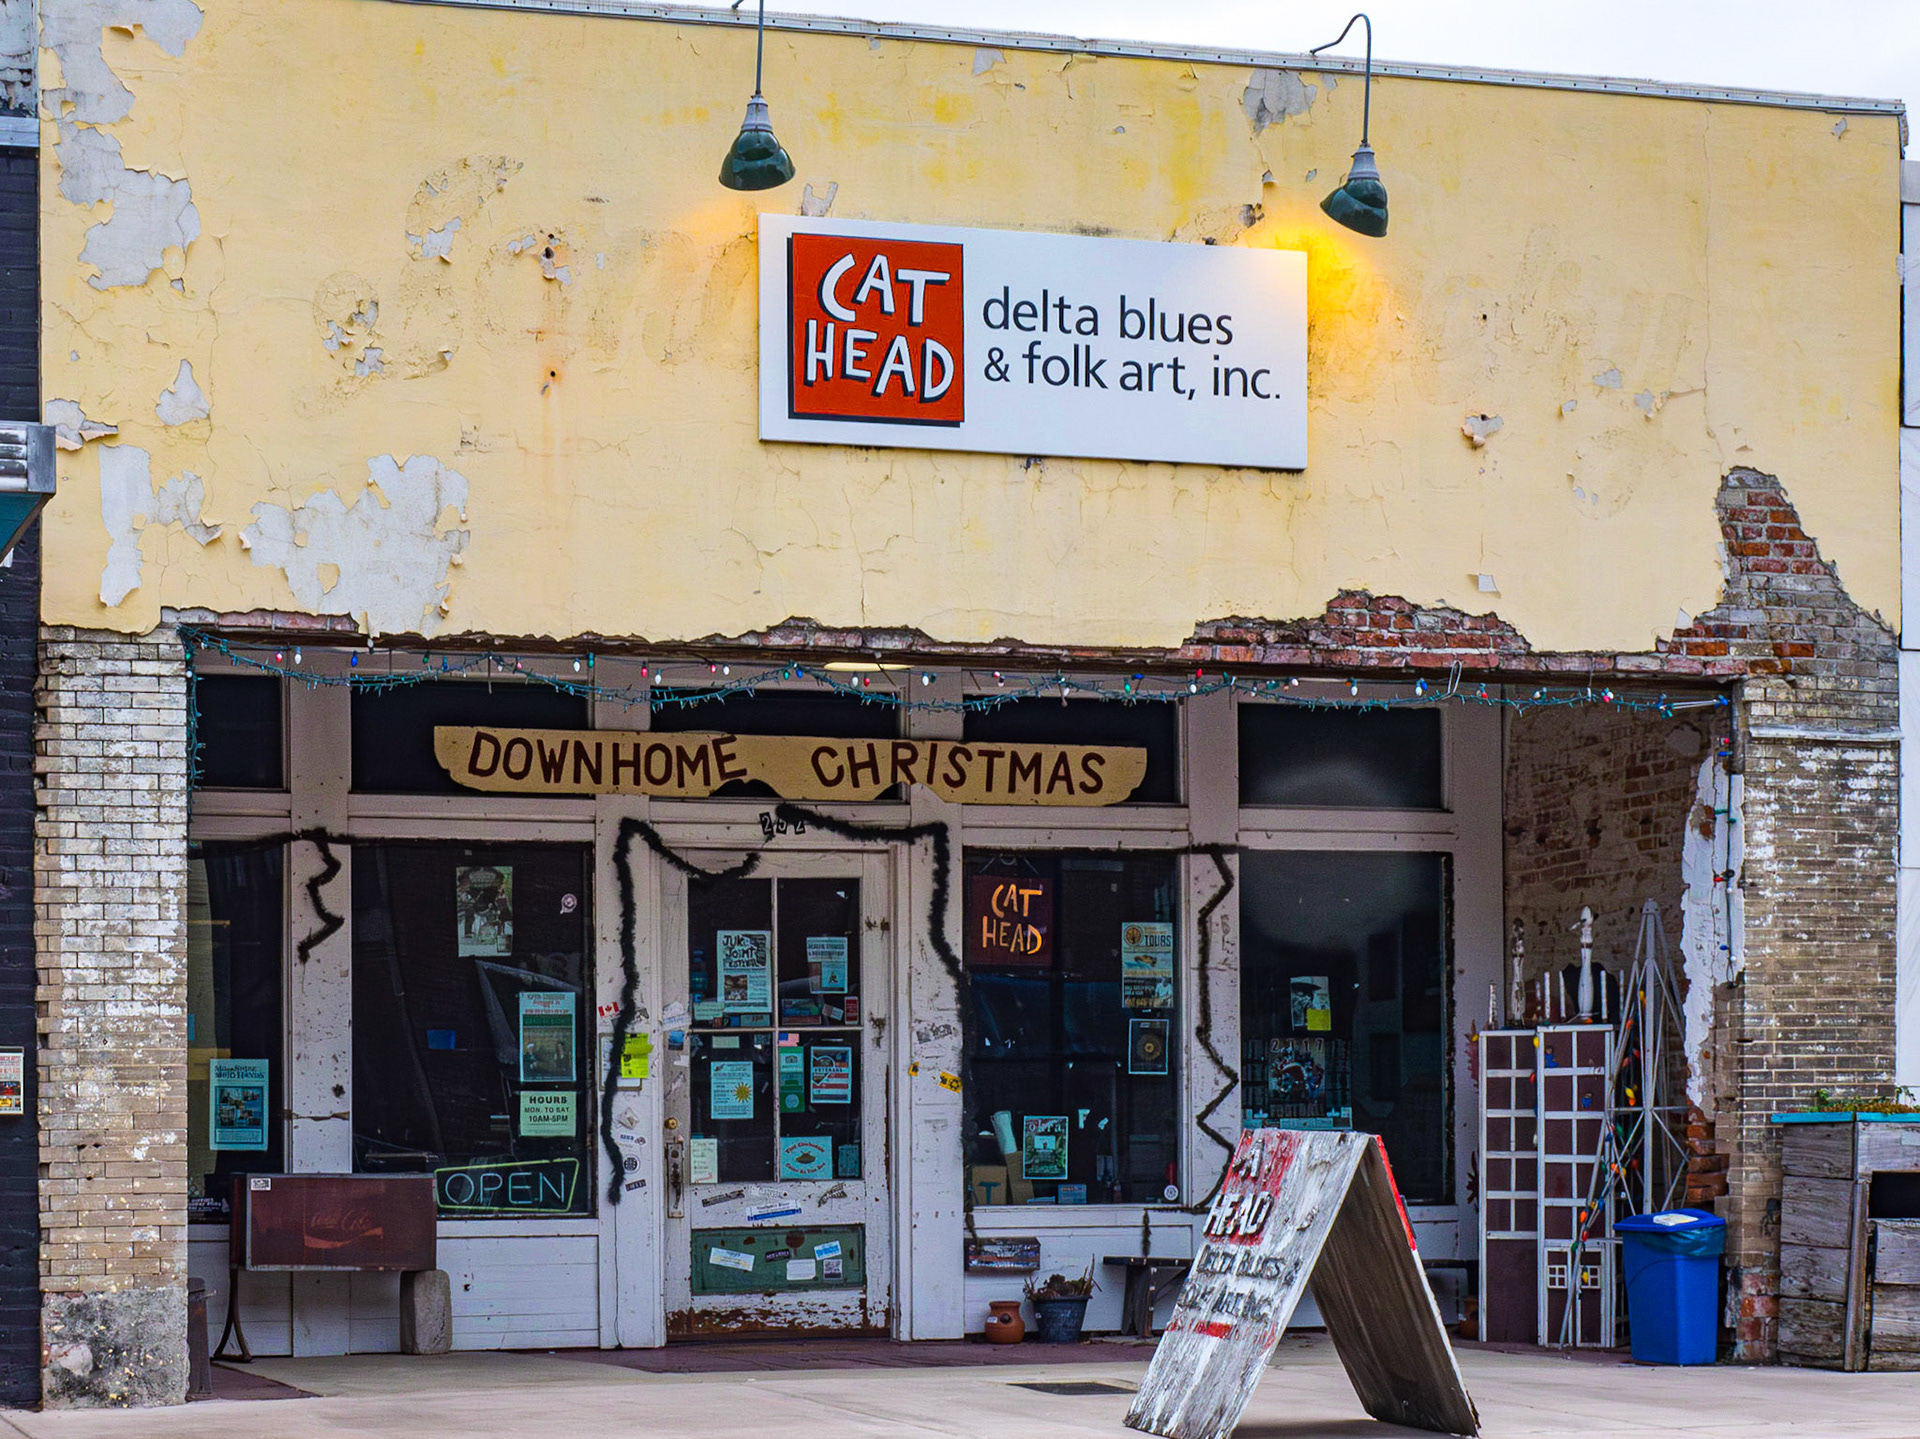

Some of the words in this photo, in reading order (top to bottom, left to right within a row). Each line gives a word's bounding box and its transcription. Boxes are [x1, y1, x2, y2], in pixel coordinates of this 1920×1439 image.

[818, 252, 951, 326] CAT
[982, 285, 1100, 337] delta
[1119, 294, 1234, 346] blues
[804, 318, 956, 404] HEAD
[983, 346, 1011, 383] &
[1021, 341, 1109, 390] folk
[1118, 355, 1197, 401] art,
[1211, 353, 1282, 400] inc.
[468, 730, 747, 789] DOWNHOME
[810, 741, 1106, 796] CHRISTMAS
[991, 883, 1043, 918] CAT
[981, 915, 1043, 955] HEAD
[528, 1095, 568, 1105] HOURS
[444, 1171, 565, 1205] OPEN
[1202, 1190, 1274, 1237] HEAD
